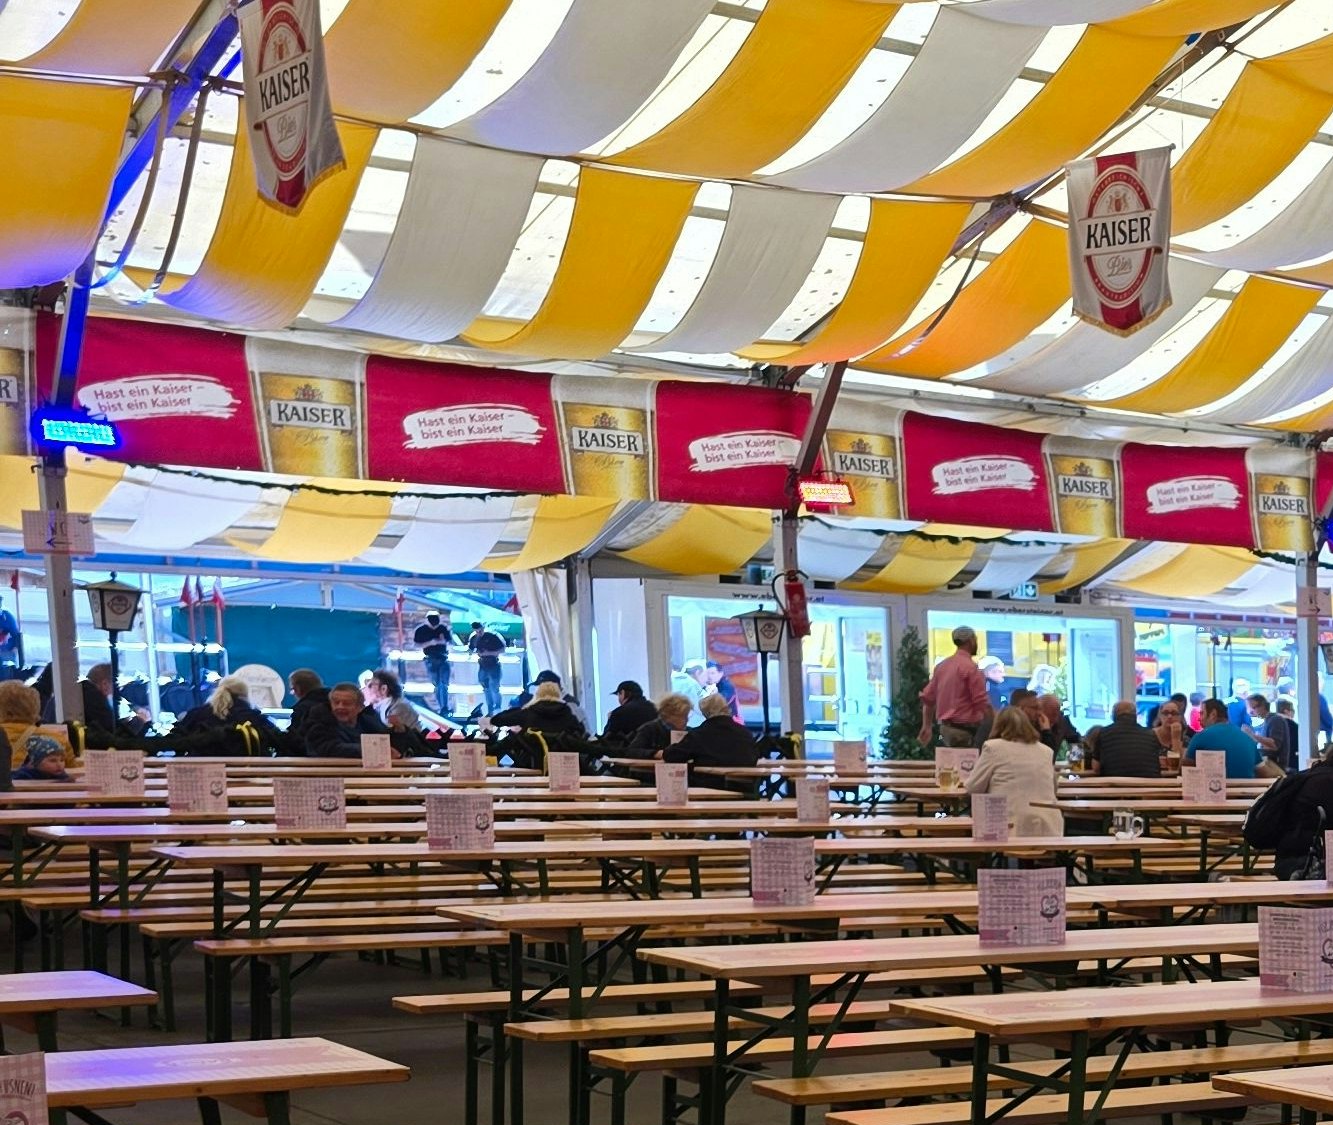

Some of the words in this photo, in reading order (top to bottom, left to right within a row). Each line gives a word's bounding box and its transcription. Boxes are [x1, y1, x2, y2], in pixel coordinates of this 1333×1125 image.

[258, 60, 310, 112] KAISER
[1086, 216, 1152, 248] KAISER
[94, 387, 124, 401] Hast
[129, 386, 150, 398] ein
[152, 382, 193, 396] Kaiser
[127, 398, 149, 409] ein
[152, 396, 192, 408] Kaiser
[277, 403, 346, 427] KAISER
[418, 416, 445, 428] Hast
[448, 414, 467, 426] ein
[468, 412, 505, 424] Kaiser
[421, 428, 444, 439] bist
[447, 427, 465, 437] ein
[468, 424, 503, 435] Kaiser
[578, 429, 639, 452] KAISER
[839, 456, 890, 475] KAISER
[1062, 477, 1108, 496] KAISER
[1262, 495, 1305, 513] KAISER
